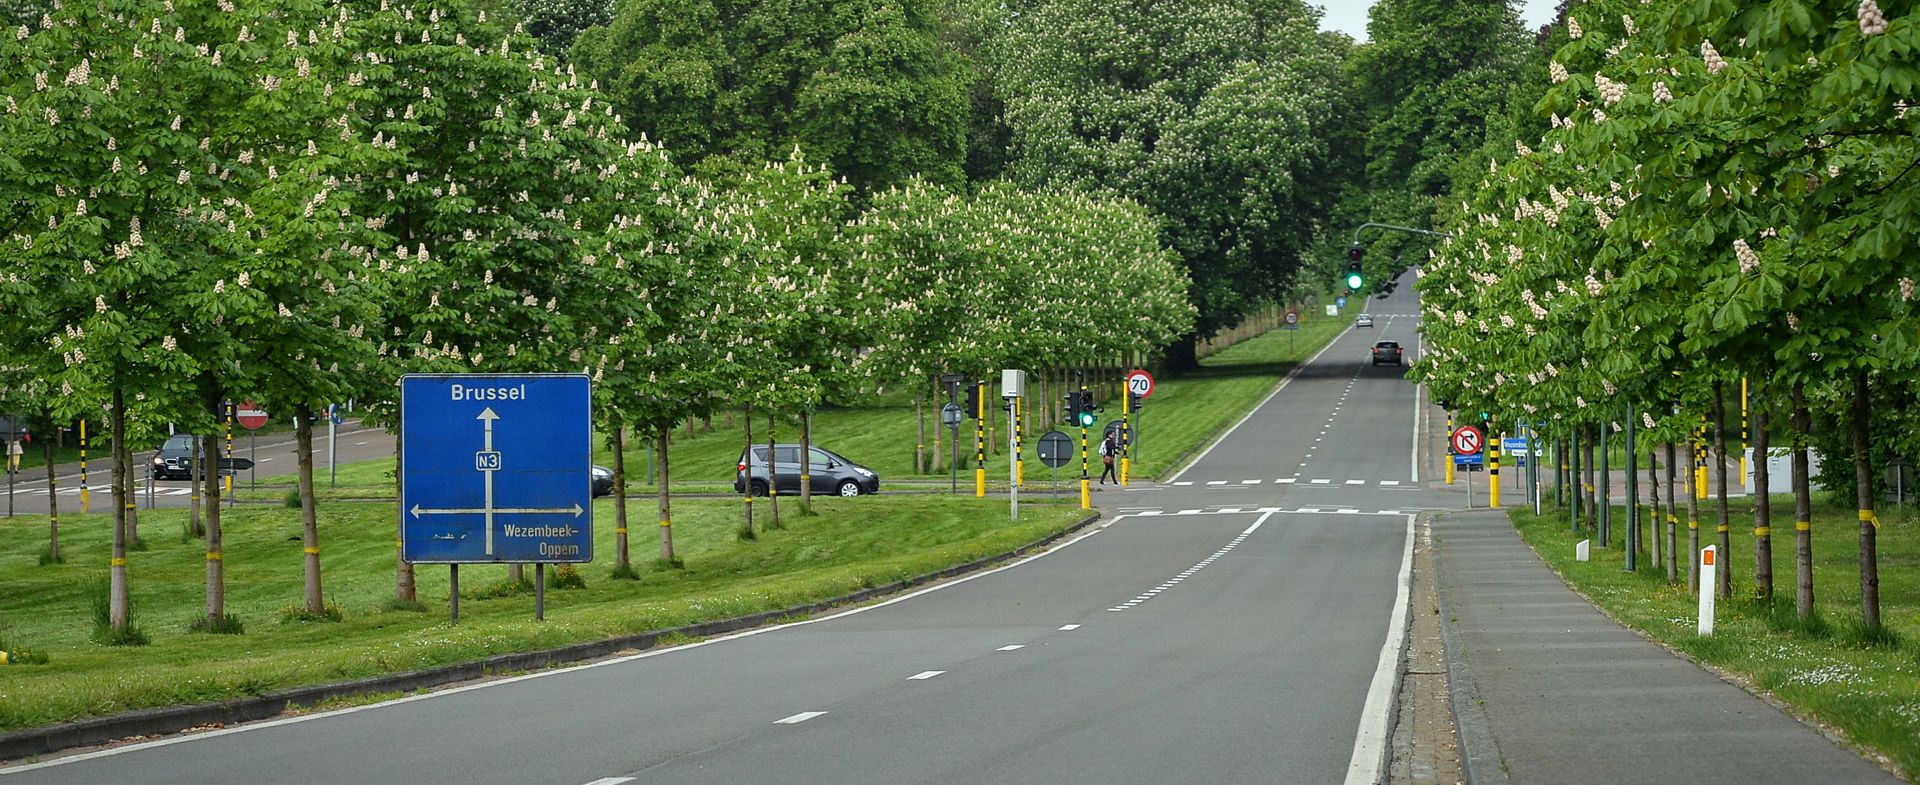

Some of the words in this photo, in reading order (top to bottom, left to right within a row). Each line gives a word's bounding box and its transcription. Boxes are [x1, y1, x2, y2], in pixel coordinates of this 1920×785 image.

[1132, 379, 1148, 391] 70
[451, 384, 526, 401] Brussel
[479, 454, 498, 468] N3
[504, 524, 579, 538] Wezembeek-
[539, 542, 579, 558] Oppem
